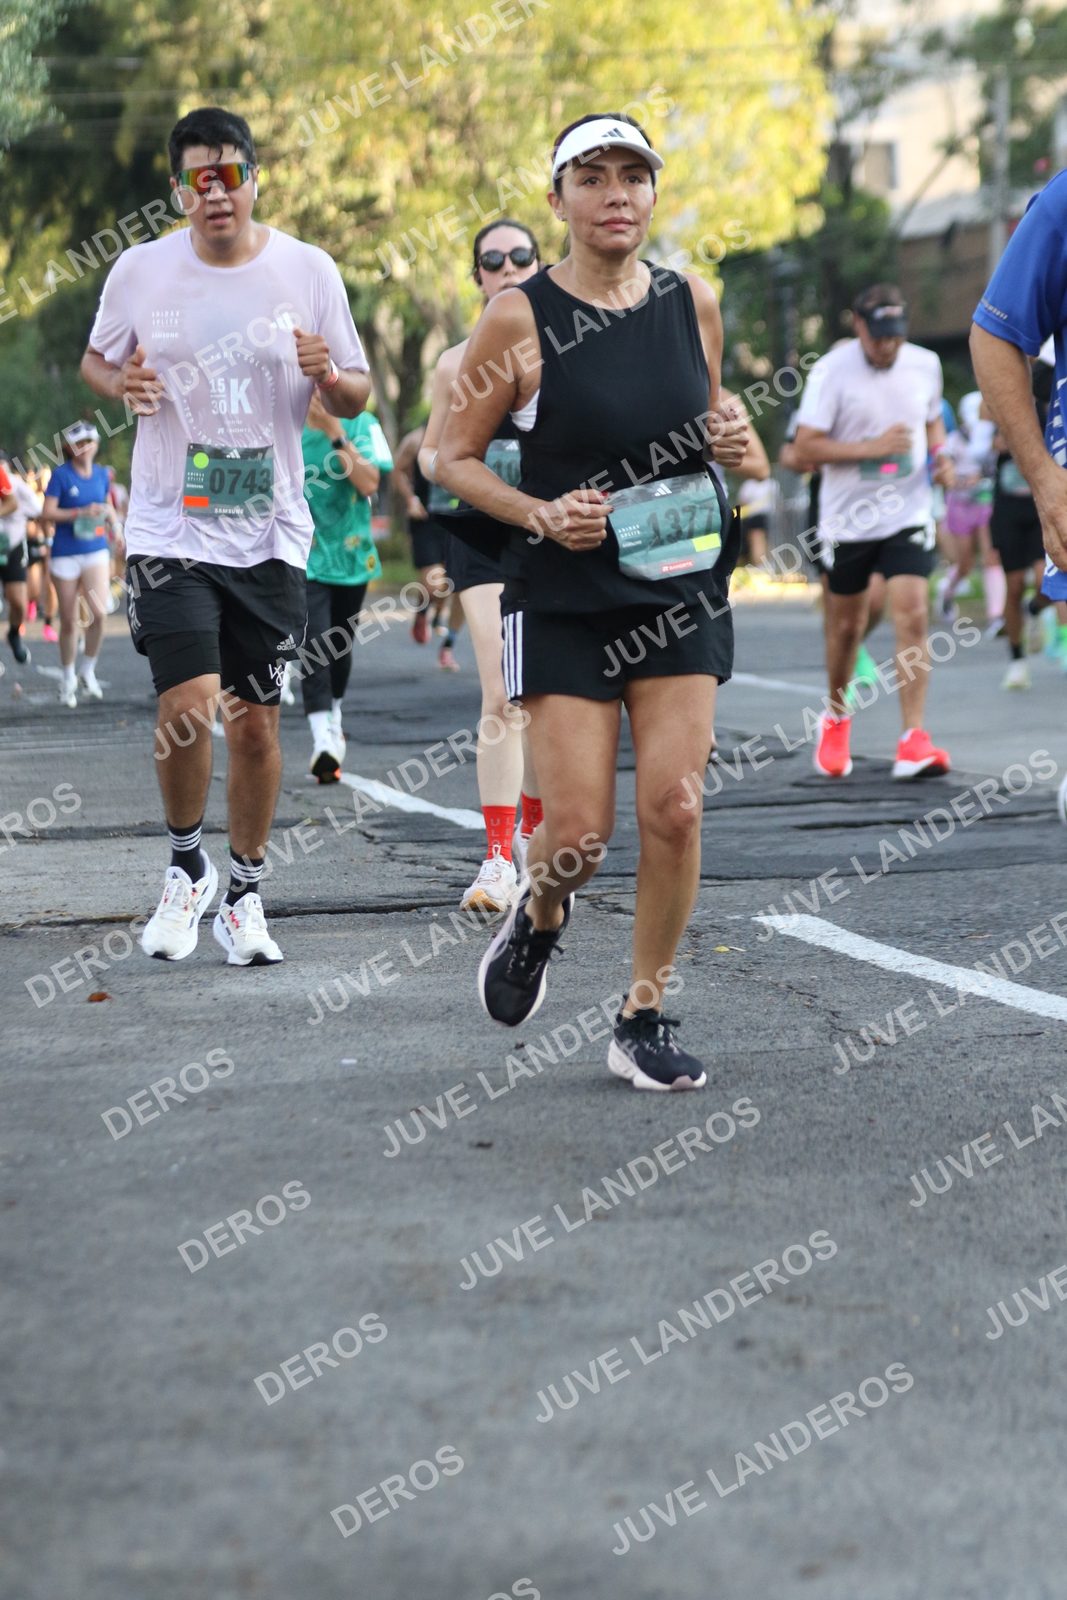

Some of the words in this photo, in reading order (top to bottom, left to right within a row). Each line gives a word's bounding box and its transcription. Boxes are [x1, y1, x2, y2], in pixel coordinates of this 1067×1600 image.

[209, 378, 226, 393] 15
[230, 377, 253, 415] K
[211, 399, 227, 415] 30
[209, 467, 271, 495] 0743
